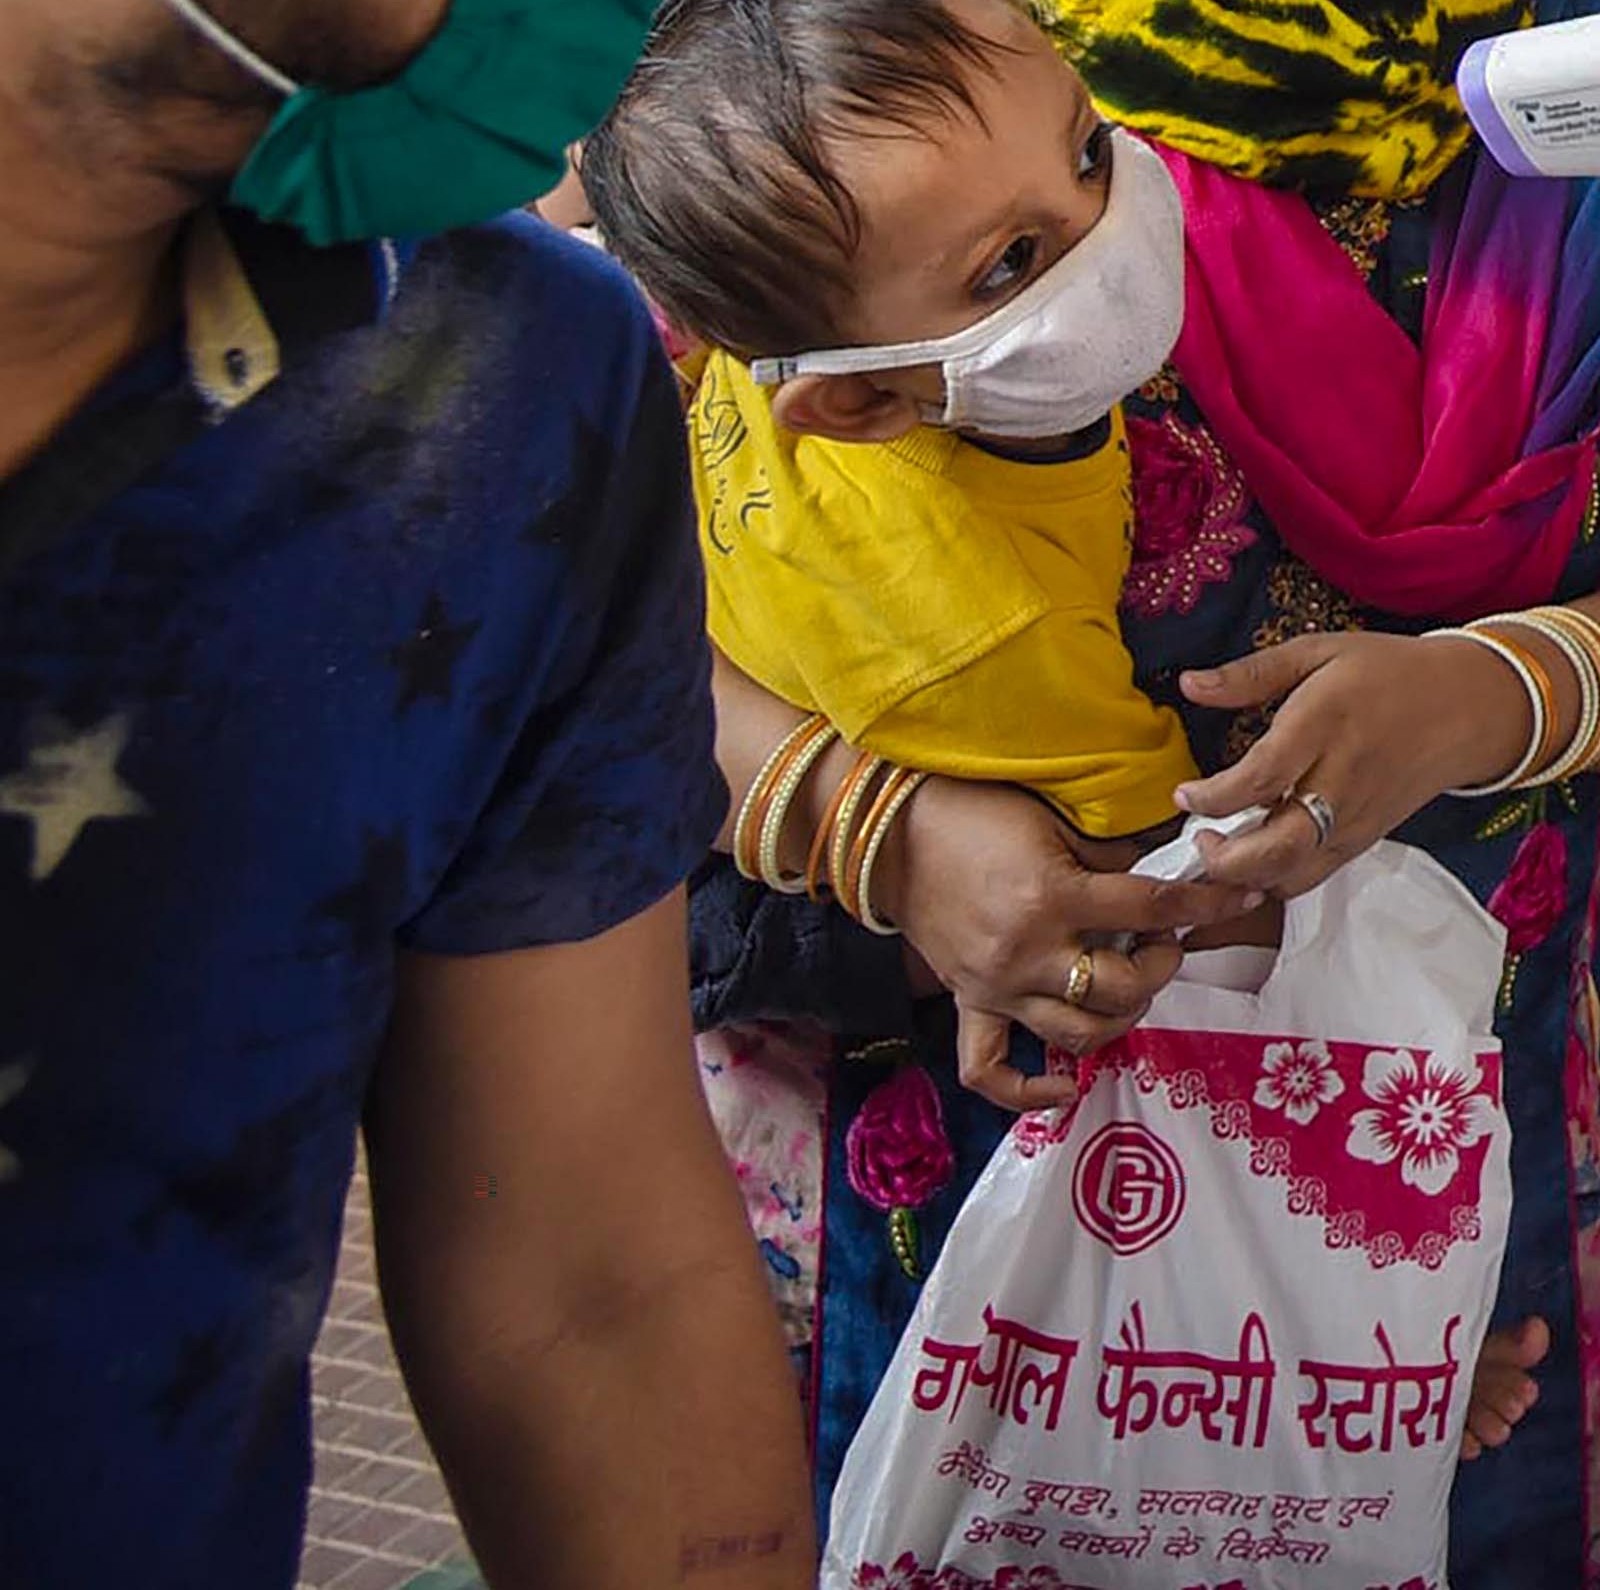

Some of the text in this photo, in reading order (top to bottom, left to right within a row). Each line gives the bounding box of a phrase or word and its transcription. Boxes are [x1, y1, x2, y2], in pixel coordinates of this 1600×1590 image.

[1097, 1299, 1275, 1448] फैन्सी
[1297, 1314, 1461, 1452] स्टोर्स
[1136, 1489, 1265, 1520] सलवार
[1271, 1493, 1330, 1531] सूट
[1337, 1489, 1395, 1528] एवं
[964, 1516, 1046, 1548] अन्य
[1163, 1526, 1204, 1561] के
[1216, 1526, 1330, 1563] विक्रेता
